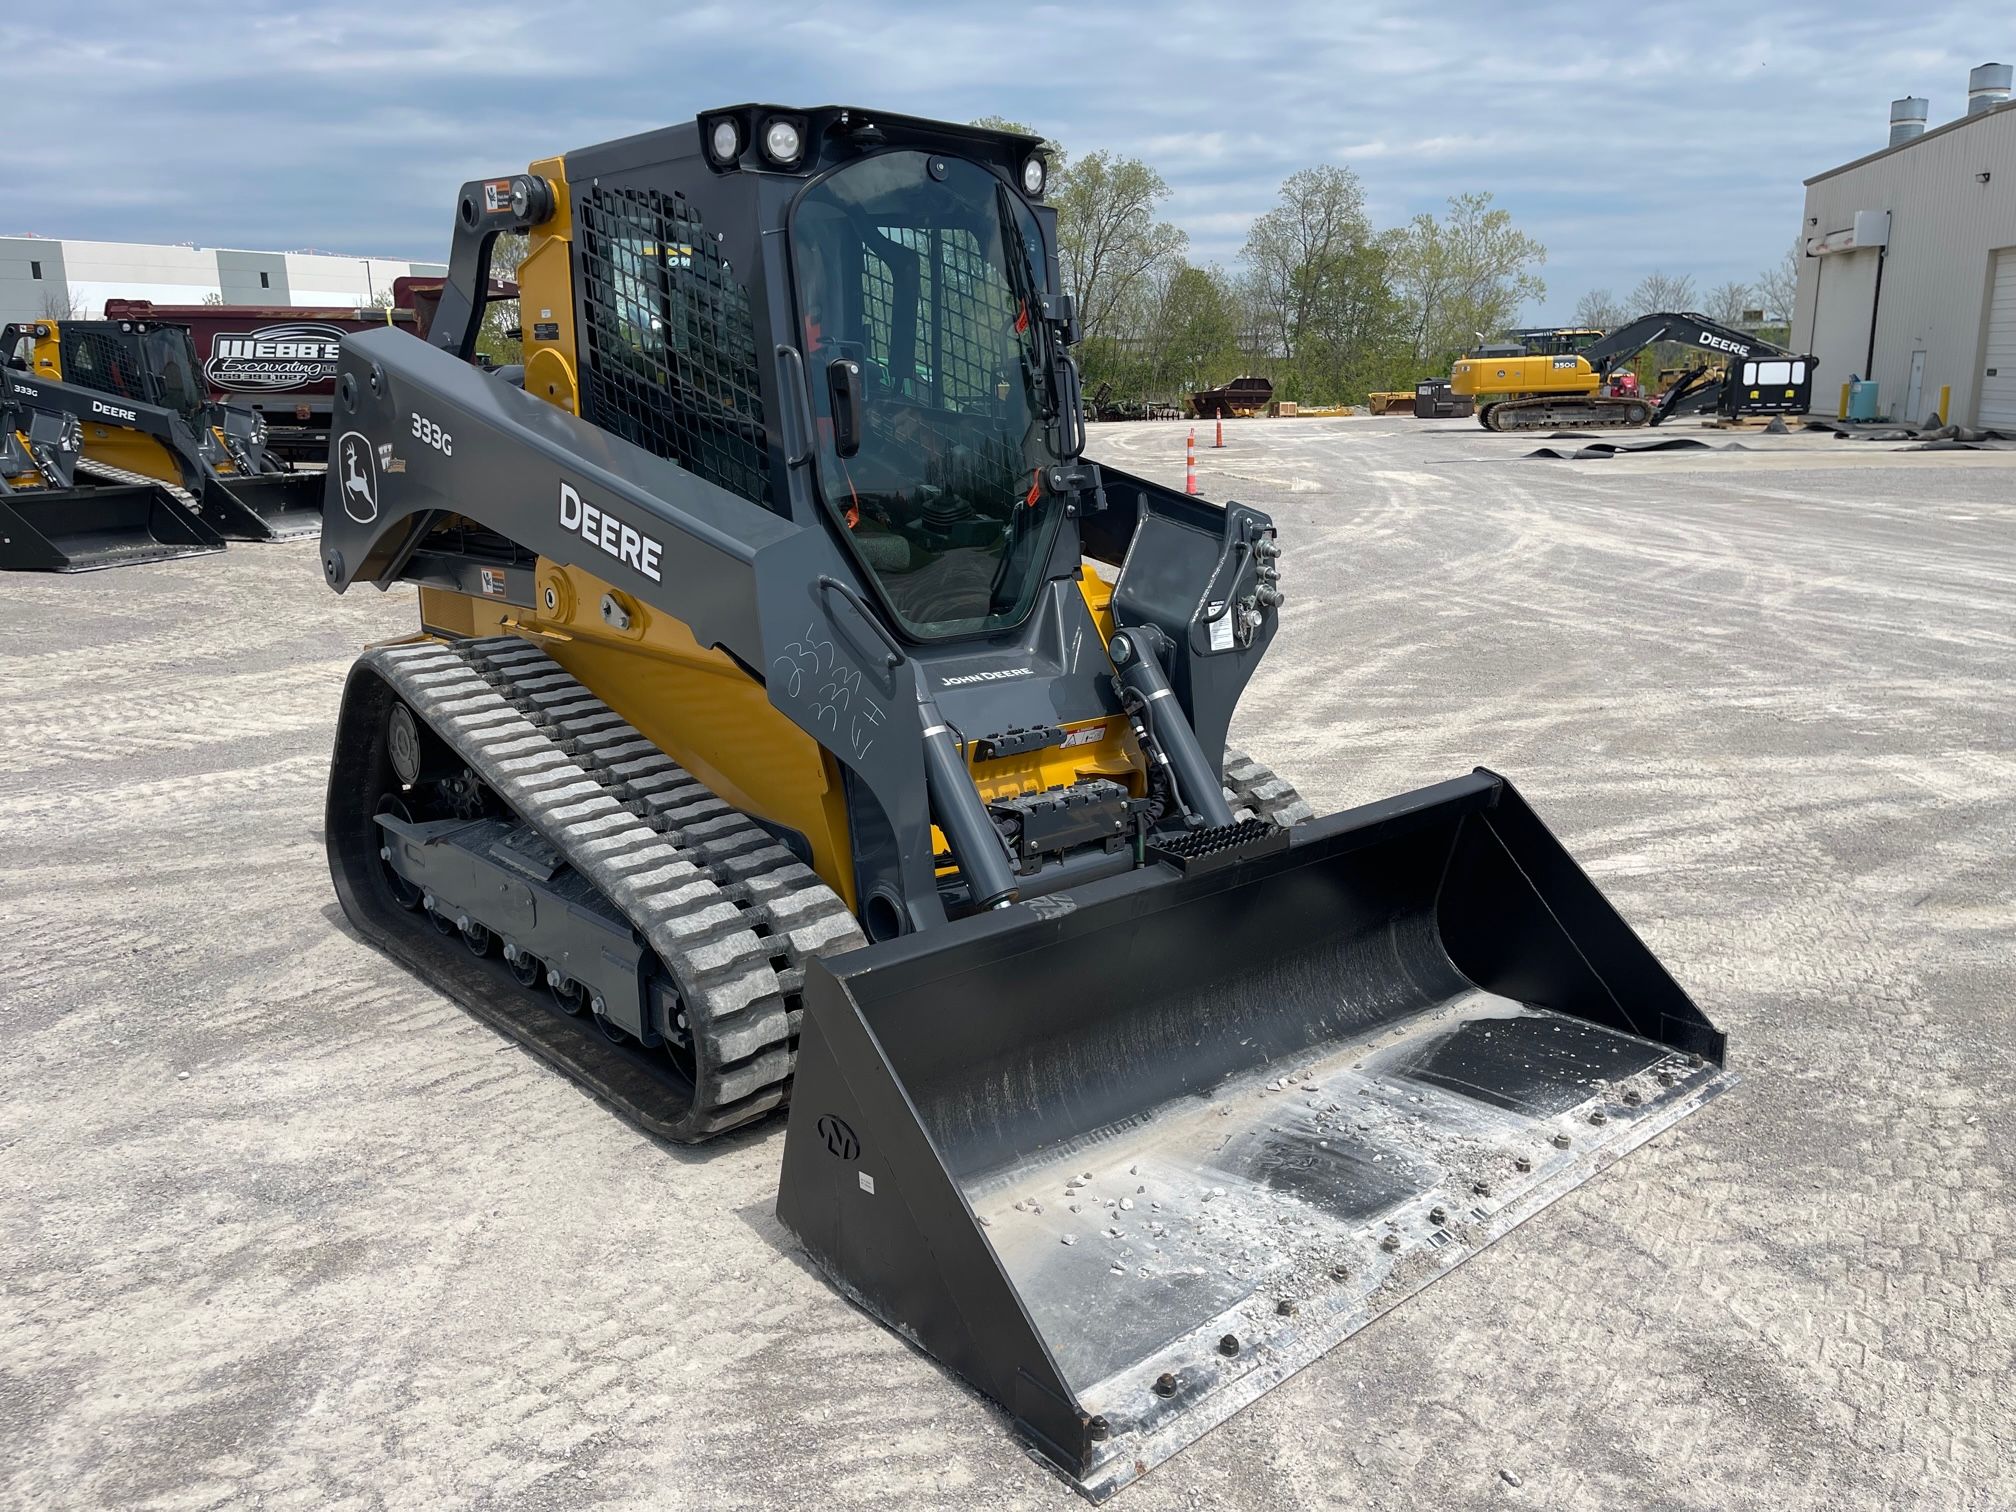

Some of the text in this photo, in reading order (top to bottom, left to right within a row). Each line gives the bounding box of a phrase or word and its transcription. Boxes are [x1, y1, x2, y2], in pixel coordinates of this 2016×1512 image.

[219, 340, 340, 359] WEBB'S
[1698, 331, 1751, 357] DEERE
[222, 359, 321, 376] Excavating
[14, 384, 38, 397] 333G
[92, 400, 137, 421] DEERE
[411, 412, 452, 456] 333G
[560, 482, 662, 582] DEERE
[773, 622, 834, 698] 235
[942, 667, 1034, 686] JOHN DEERE
[807, 666, 861, 732] 333
